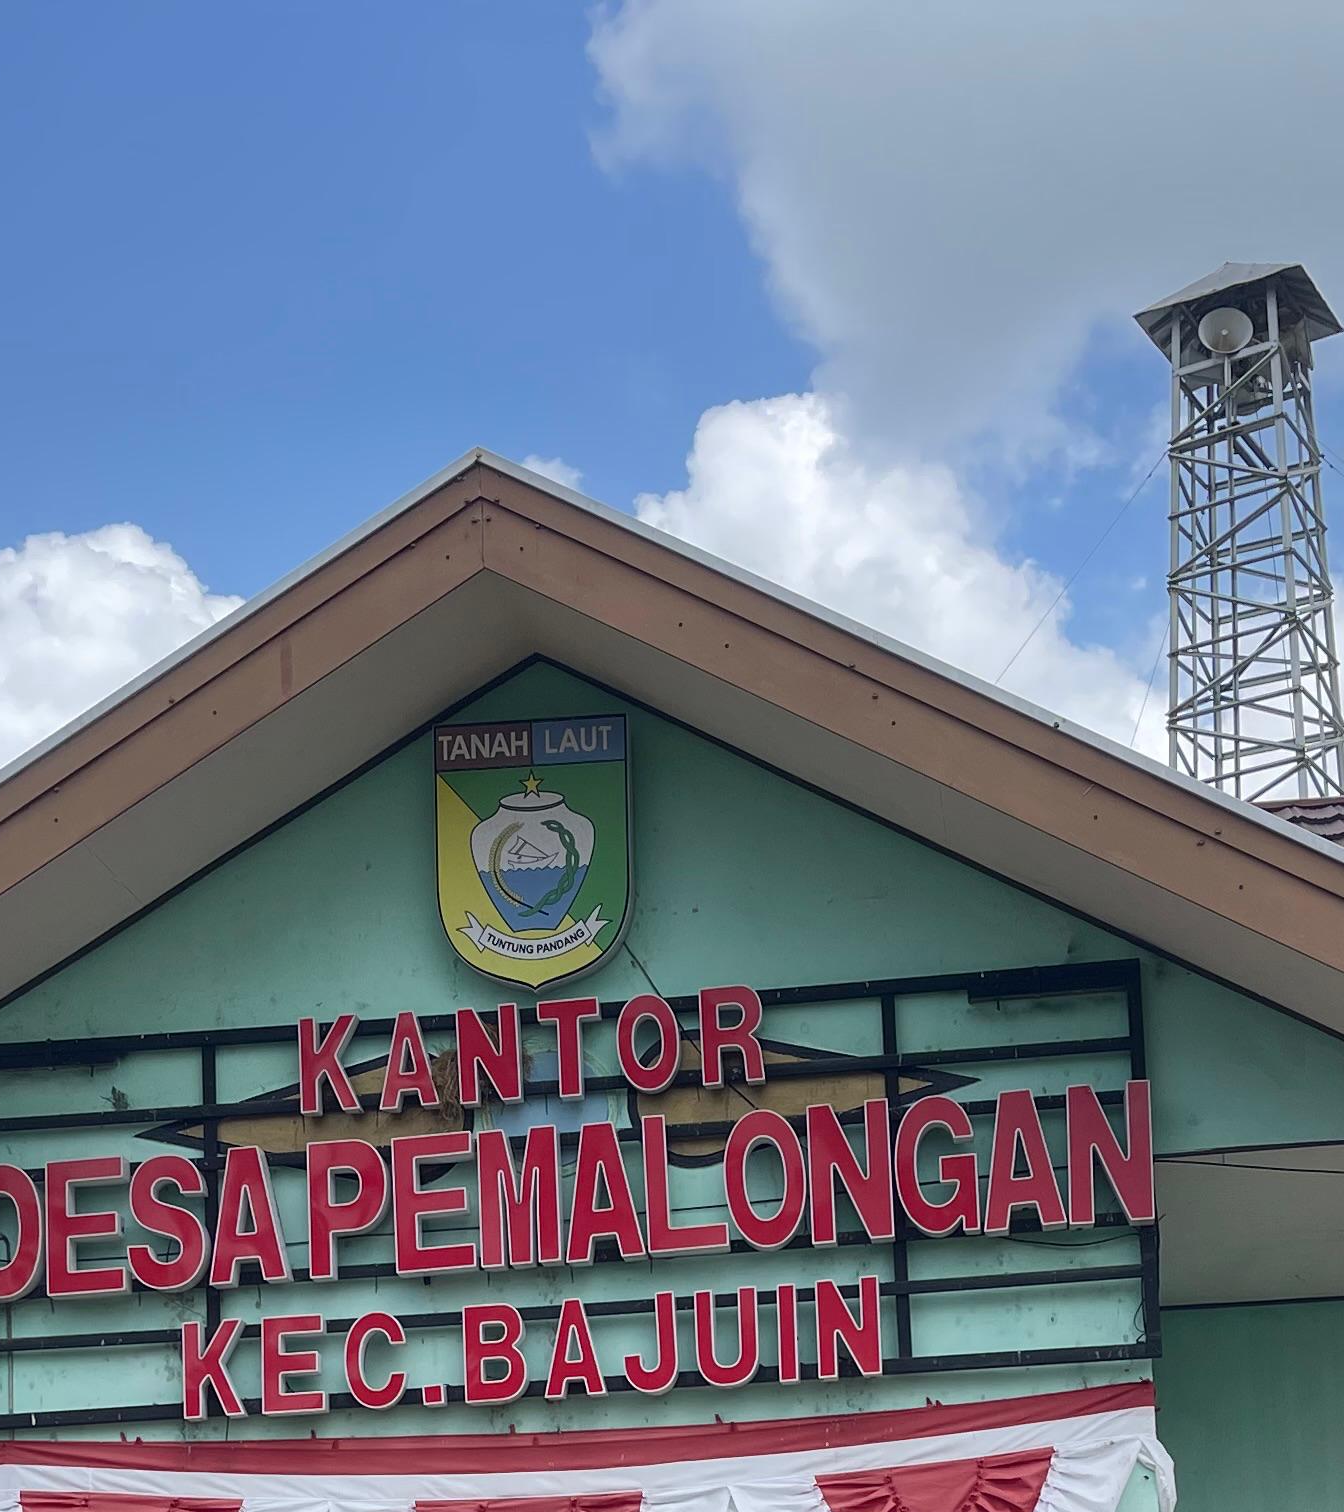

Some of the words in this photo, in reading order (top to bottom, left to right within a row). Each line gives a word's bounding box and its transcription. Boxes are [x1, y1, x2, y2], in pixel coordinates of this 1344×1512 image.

[438, 730, 529, 761] TANAH
[545, 726, 612, 754] LAUT
[487, 932, 534, 954] TUNTUNG
[536, 928, 585, 954] PANDANG
[297, 985, 766, 1116] KANTOR
[307, 1078, 1156, 1281] PEMALONGAN
